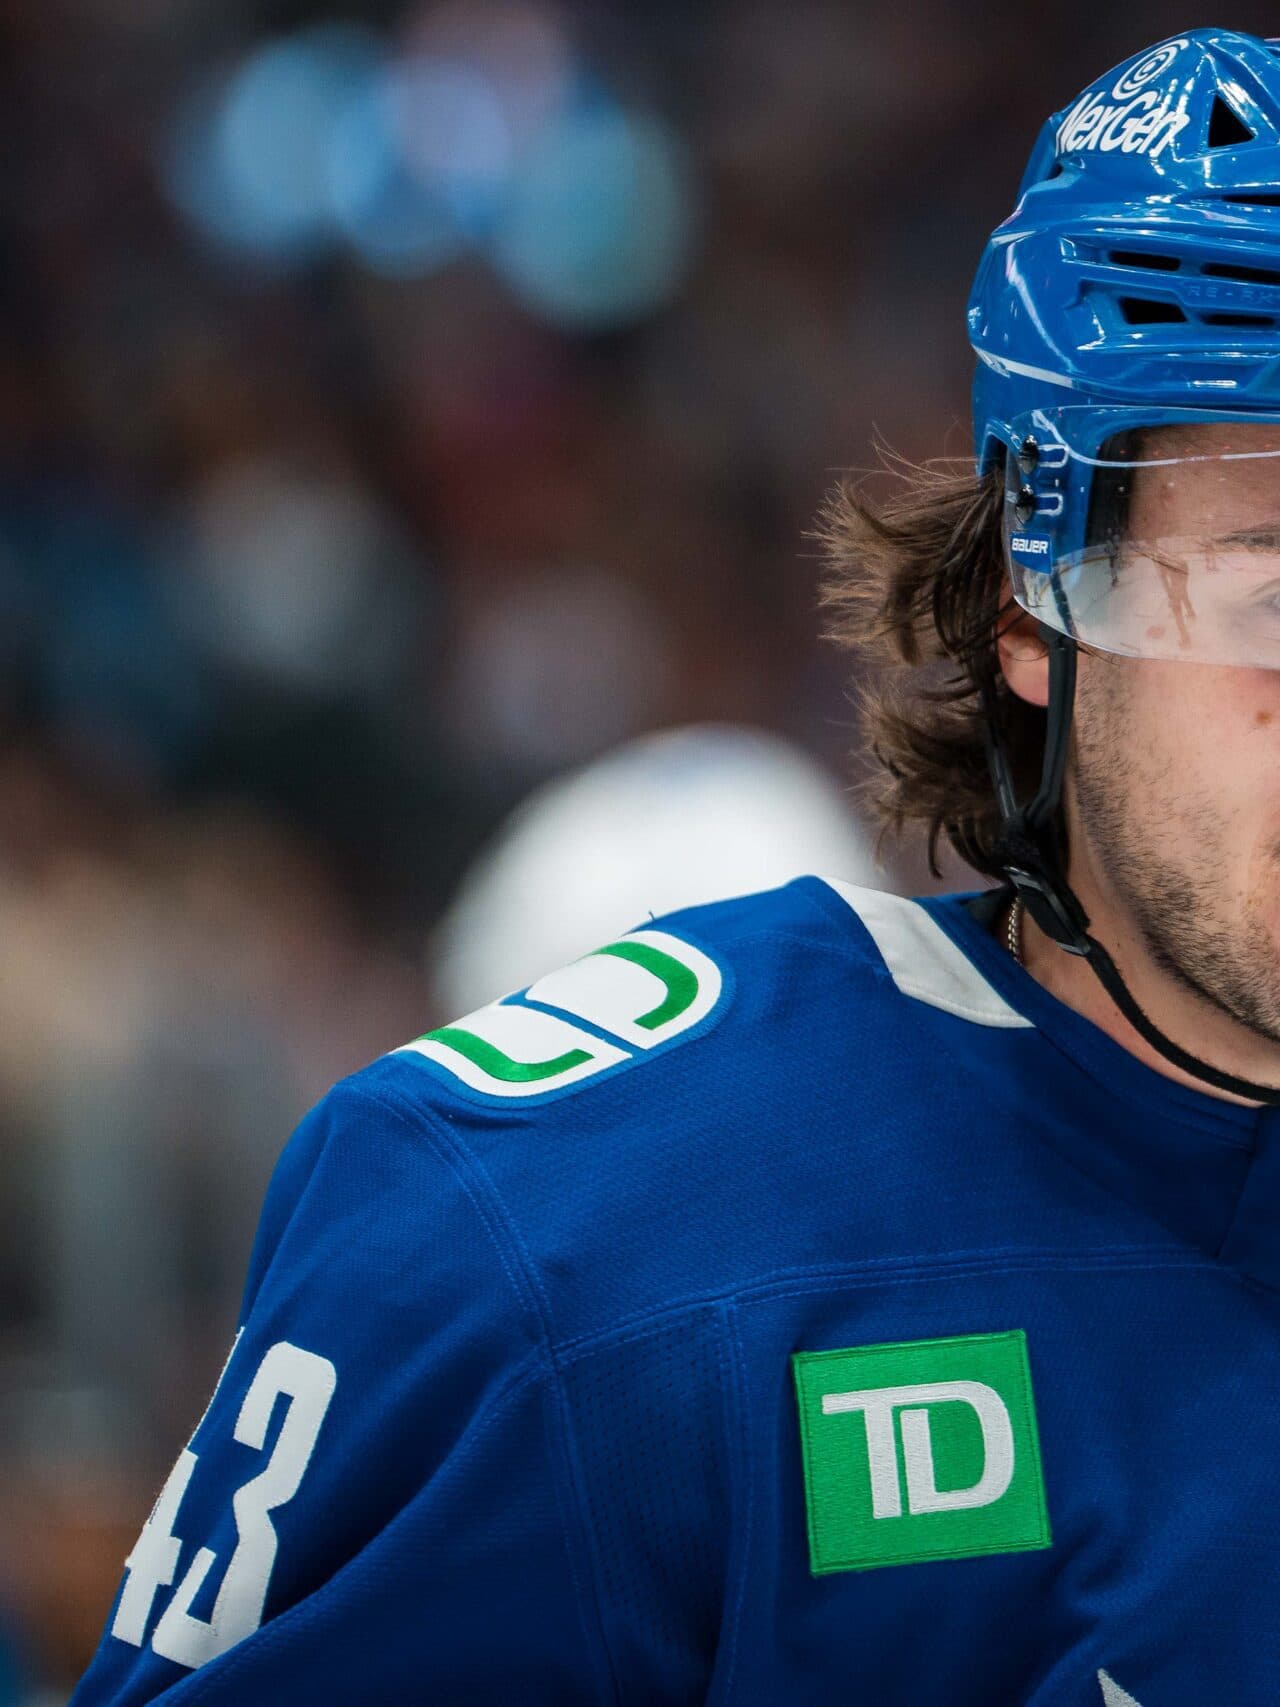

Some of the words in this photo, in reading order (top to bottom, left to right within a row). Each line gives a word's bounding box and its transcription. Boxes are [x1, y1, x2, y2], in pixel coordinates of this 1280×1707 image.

[1055, 90, 1191, 158] NexGen
[1011, 537, 1049, 555] BAUER
[111, 1326, 337, 1670] 43
[822, 1380, 1015, 1519] TD
